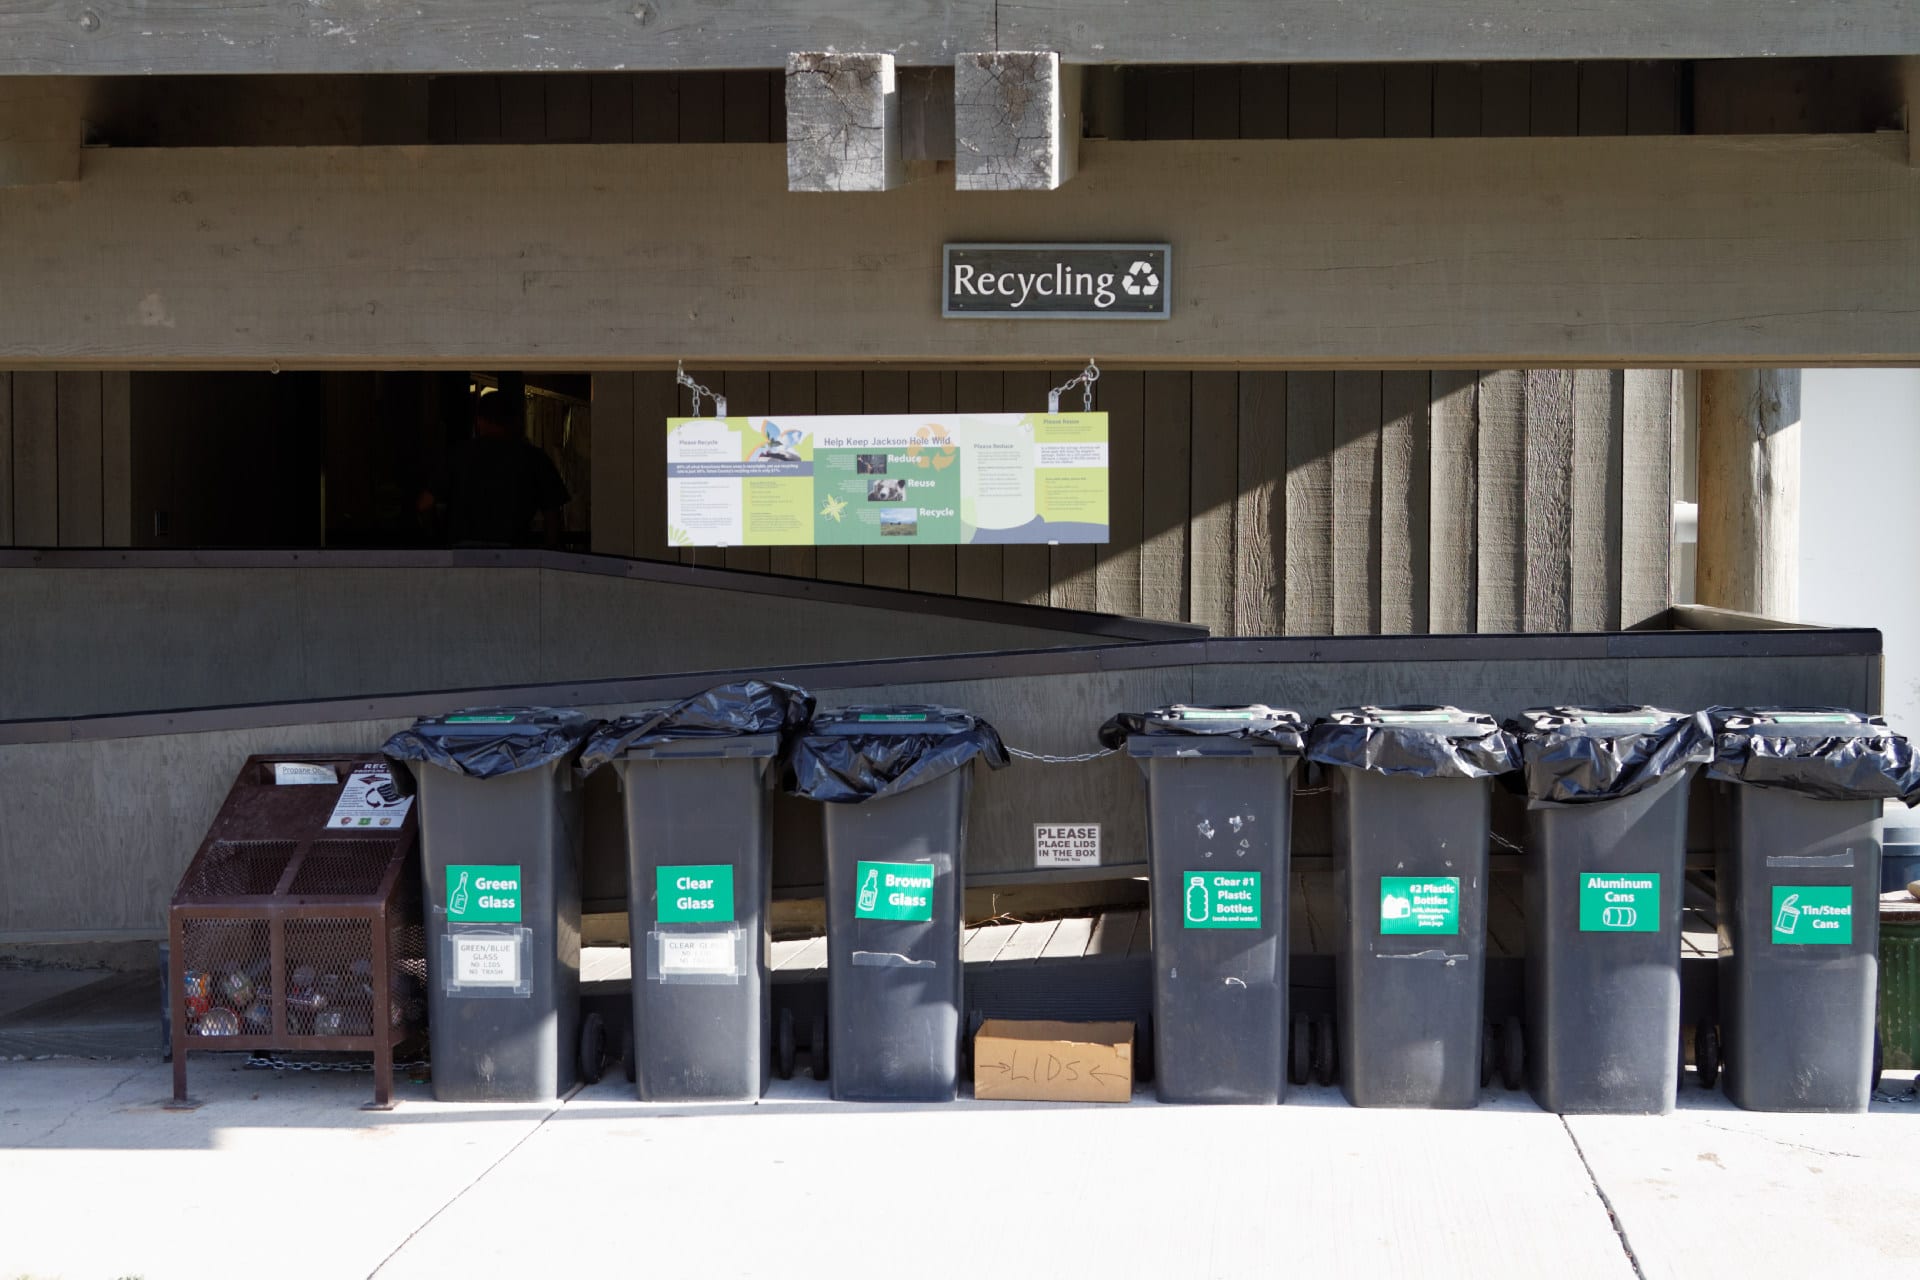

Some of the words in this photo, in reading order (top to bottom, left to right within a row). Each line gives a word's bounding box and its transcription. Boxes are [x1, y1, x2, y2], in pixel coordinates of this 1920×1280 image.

[954, 263, 1115, 308] Recycling
[824, 438, 843, 447] Help
[846, 438, 868, 447] Keep
[872, 438, 907, 446] Jackson
[909, 437, 929, 445] Hole
[931, 437, 951, 445] Wild
[888, 454, 922, 463] Reduce
[908, 479, 935, 488] Reuse
[920, 508, 954, 518] Recycle
[1038, 828, 1096, 839] PLEASE
[475, 877, 518, 890] Green
[676, 877, 714, 890] Clear
[885, 874, 931, 888] Brown
[1213, 877, 1241, 887] Clear
[1242, 877, 1255, 887] #1
[1588, 878, 1653, 889] Aluminum
[1410, 884, 1422, 893] #2
[1423, 884, 1455, 893] Plastic
[888, 893, 927, 907] Glass
[1218, 890, 1252, 900] Plastic
[1604, 891, 1635, 903] Cans
[478, 896, 515, 908] Glass
[676, 896, 714, 910] Glass
[1413, 896, 1448, 905] Bottles
[1216, 903, 1253, 913] Bottles
[1801, 904, 1852, 915] Tin/Steel
[1812, 919, 1840, 929] Cans
[460, 944, 511, 952] GREEN/BLUE
[669, 942, 694, 950] CLEAR
[1011, 1049, 1081, 1083] LIDS
